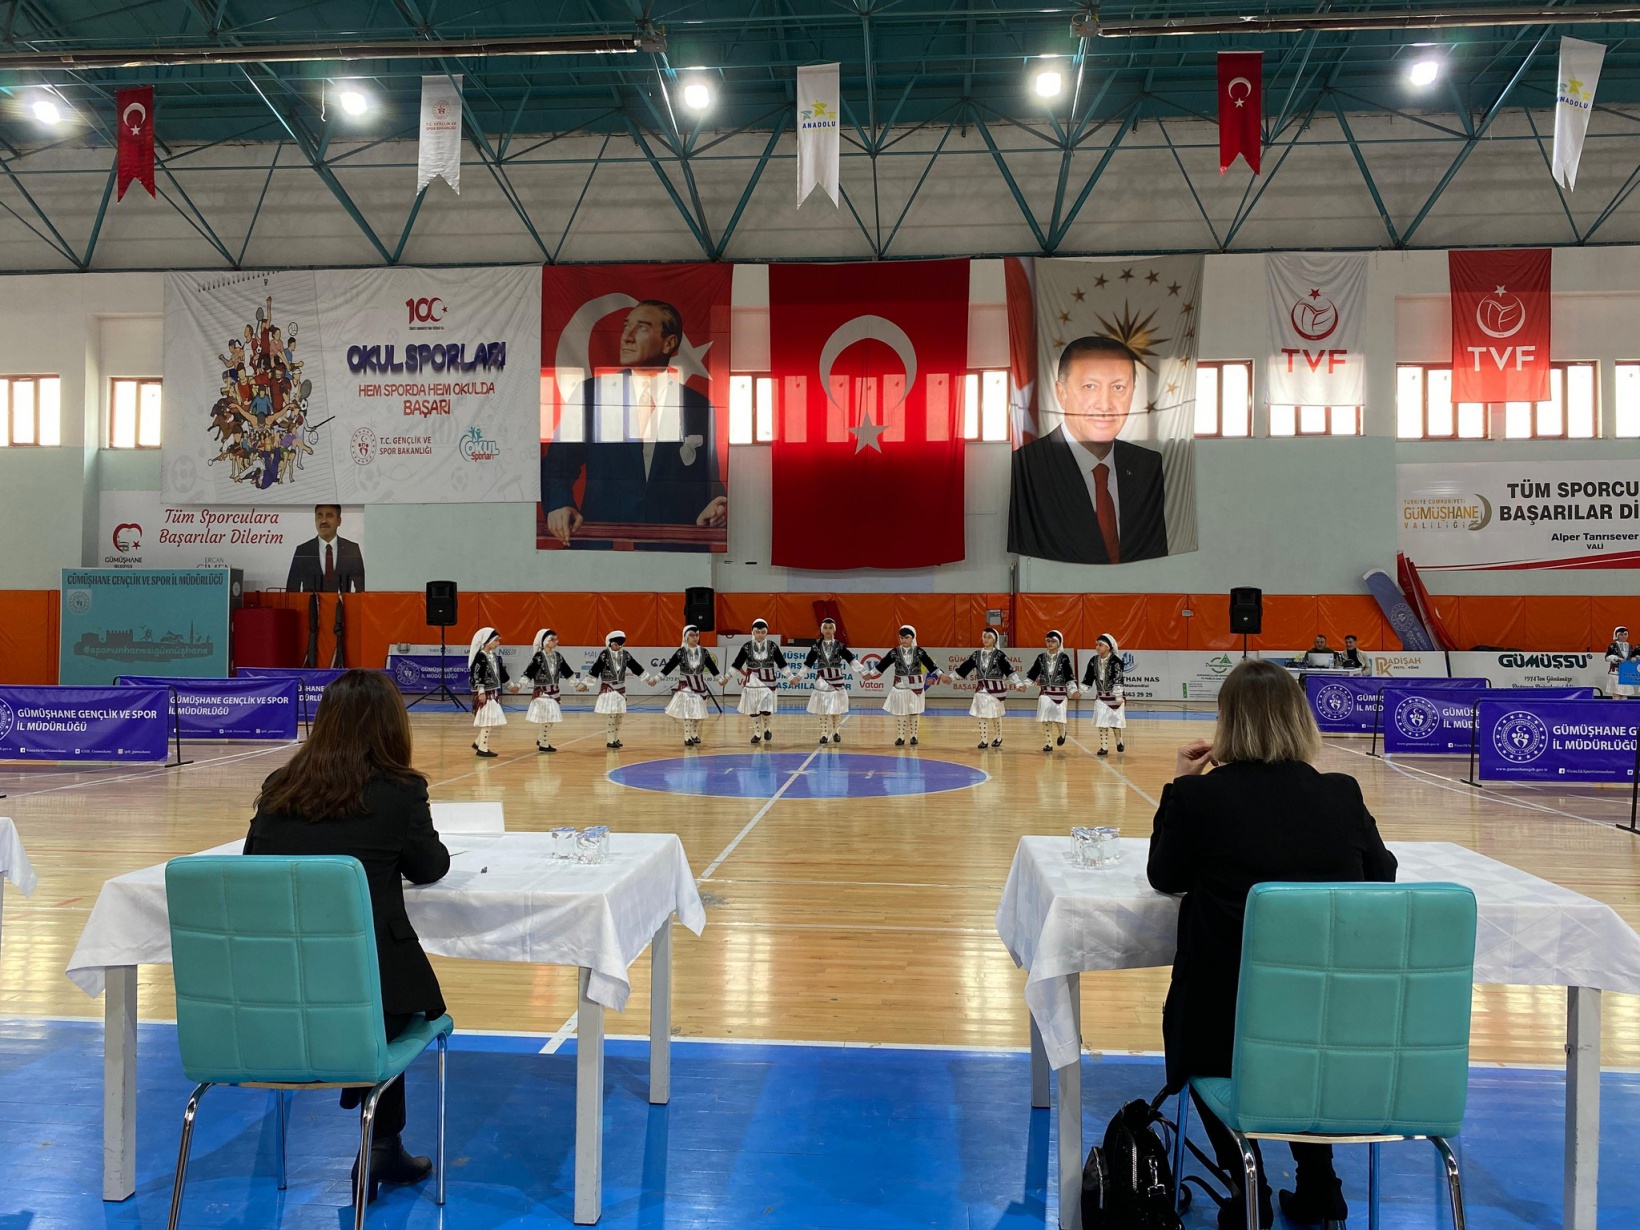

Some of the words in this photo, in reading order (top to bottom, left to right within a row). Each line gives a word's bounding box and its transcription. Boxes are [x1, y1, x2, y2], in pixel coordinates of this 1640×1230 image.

[802, 121, 836, 129] ANADOLU
[347, 344, 404, 375] OKUL
[404, 341, 507, 374] SPORLARI
[1281, 348, 1348, 374] TVF
[1467, 345, 1536, 372] TVF
[359, 384, 381, 397] HEM
[384, 383, 426, 397] SPORDA
[428, 383, 451, 396] HEM
[453, 382, 495, 395] OKULDA
[403, 399, 451, 418] BAŞARI
[393, 436, 421, 446] GENÇLİK
[380, 447, 396, 455] SPOR
[398, 446, 432, 455] BAKANLIĞI
[465, 441, 500, 457] OKUL
[1507, 479, 1551, 499] TÜM
[1557, 481, 1639, 498] SPORCU
[165, 509, 195, 524] Tüm
[200, 509, 279, 528] Sporculara
[1404, 506, 1479, 522] GÜMÜŞHANE
[1500, 504, 1612, 526] BAŞARILAR
[1620, 499, 1639, 519] Dİ
[1404, 521, 1465, 529] VALİLİĞİ
[159, 528, 226, 547] Başarılar
[230, 529, 283, 544] Dilerim
[1551, 533, 1580, 542] Alper
[1583, 532, 1639, 541] Tanrısever
[105, 556, 142, 564] GÜMÜŞHANE
[67, 573, 111, 587] GÜMÜŞHANE
[112, 573, 141, 588] GENÇLİK
[142, 575, 151, 585] VE
[151, 575, 171, 585] SPOR
[172, 573, 178, 585] İL
[179, 573, 223, 586] MÜDÜRLÜĞÜ
[1498, 654, 1588, 669] GÜMÜŞSU
[777, 682, 815, 690] AŞARILA
[860, 681, 884, 689] Vatan
[170, 695, 221, 705] GÜMÜŞHANE
[222, 695, 255, 706] GENÇLİK
[17, 708, 77, 720] GÜMÜŞHANE
[78, 708, 118, 721] GENÇLİK
[119, 710, 131, 719] VE
[131, 710, 157, 719] SPOR
[168, 706, 175, 715] İL
[177, 706, 229, 715] MÜDÜRLÜĞÜ
[17, 722, 25, 731] İL
[27, 721, 87, 731] MÜDÜRLÜĞÜ
[1443, 718, 1451, 728] İL
[1553, 724, 1626, 737] GÜMÜŞHANE
[1553, 738, 1562, 750] İL
[1565, 739, 1637, 751] MÜDÜRLÜĞÜ
